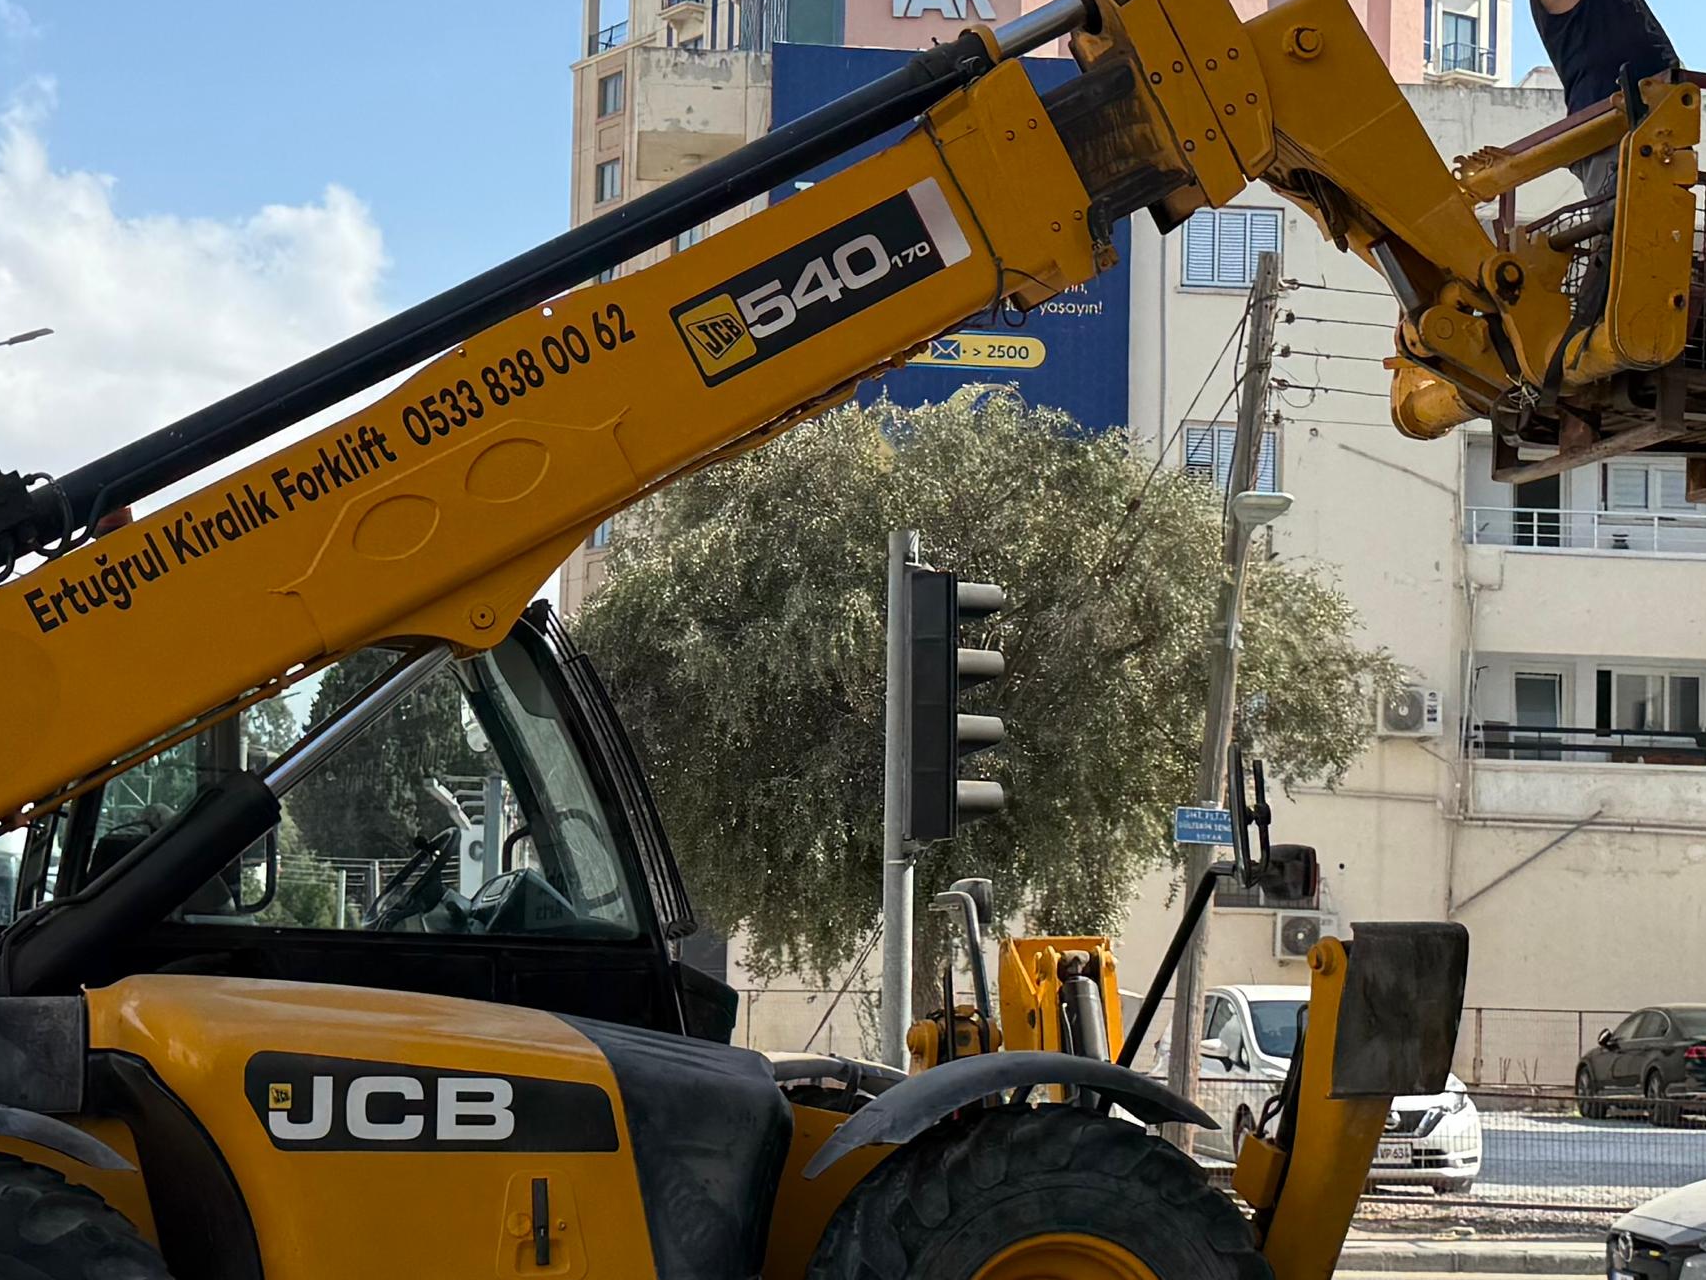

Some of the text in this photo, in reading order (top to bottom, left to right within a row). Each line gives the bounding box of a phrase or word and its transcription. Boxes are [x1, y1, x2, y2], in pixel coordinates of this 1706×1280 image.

[696, 234, 931, 354] JCB 540 170
[987, 345, 1029, 360] 2500
[23, 532, 170, 633] Ertuğrul
[271, 426, 397, 512] Forklift
[403, 379, 481, 447] 0533
[481, 349, 544, 407] 838
[541, 324, 590, 375] 00
[592, 303, 636, 350] 62
[268, 1075, 515, 1141] JCB
